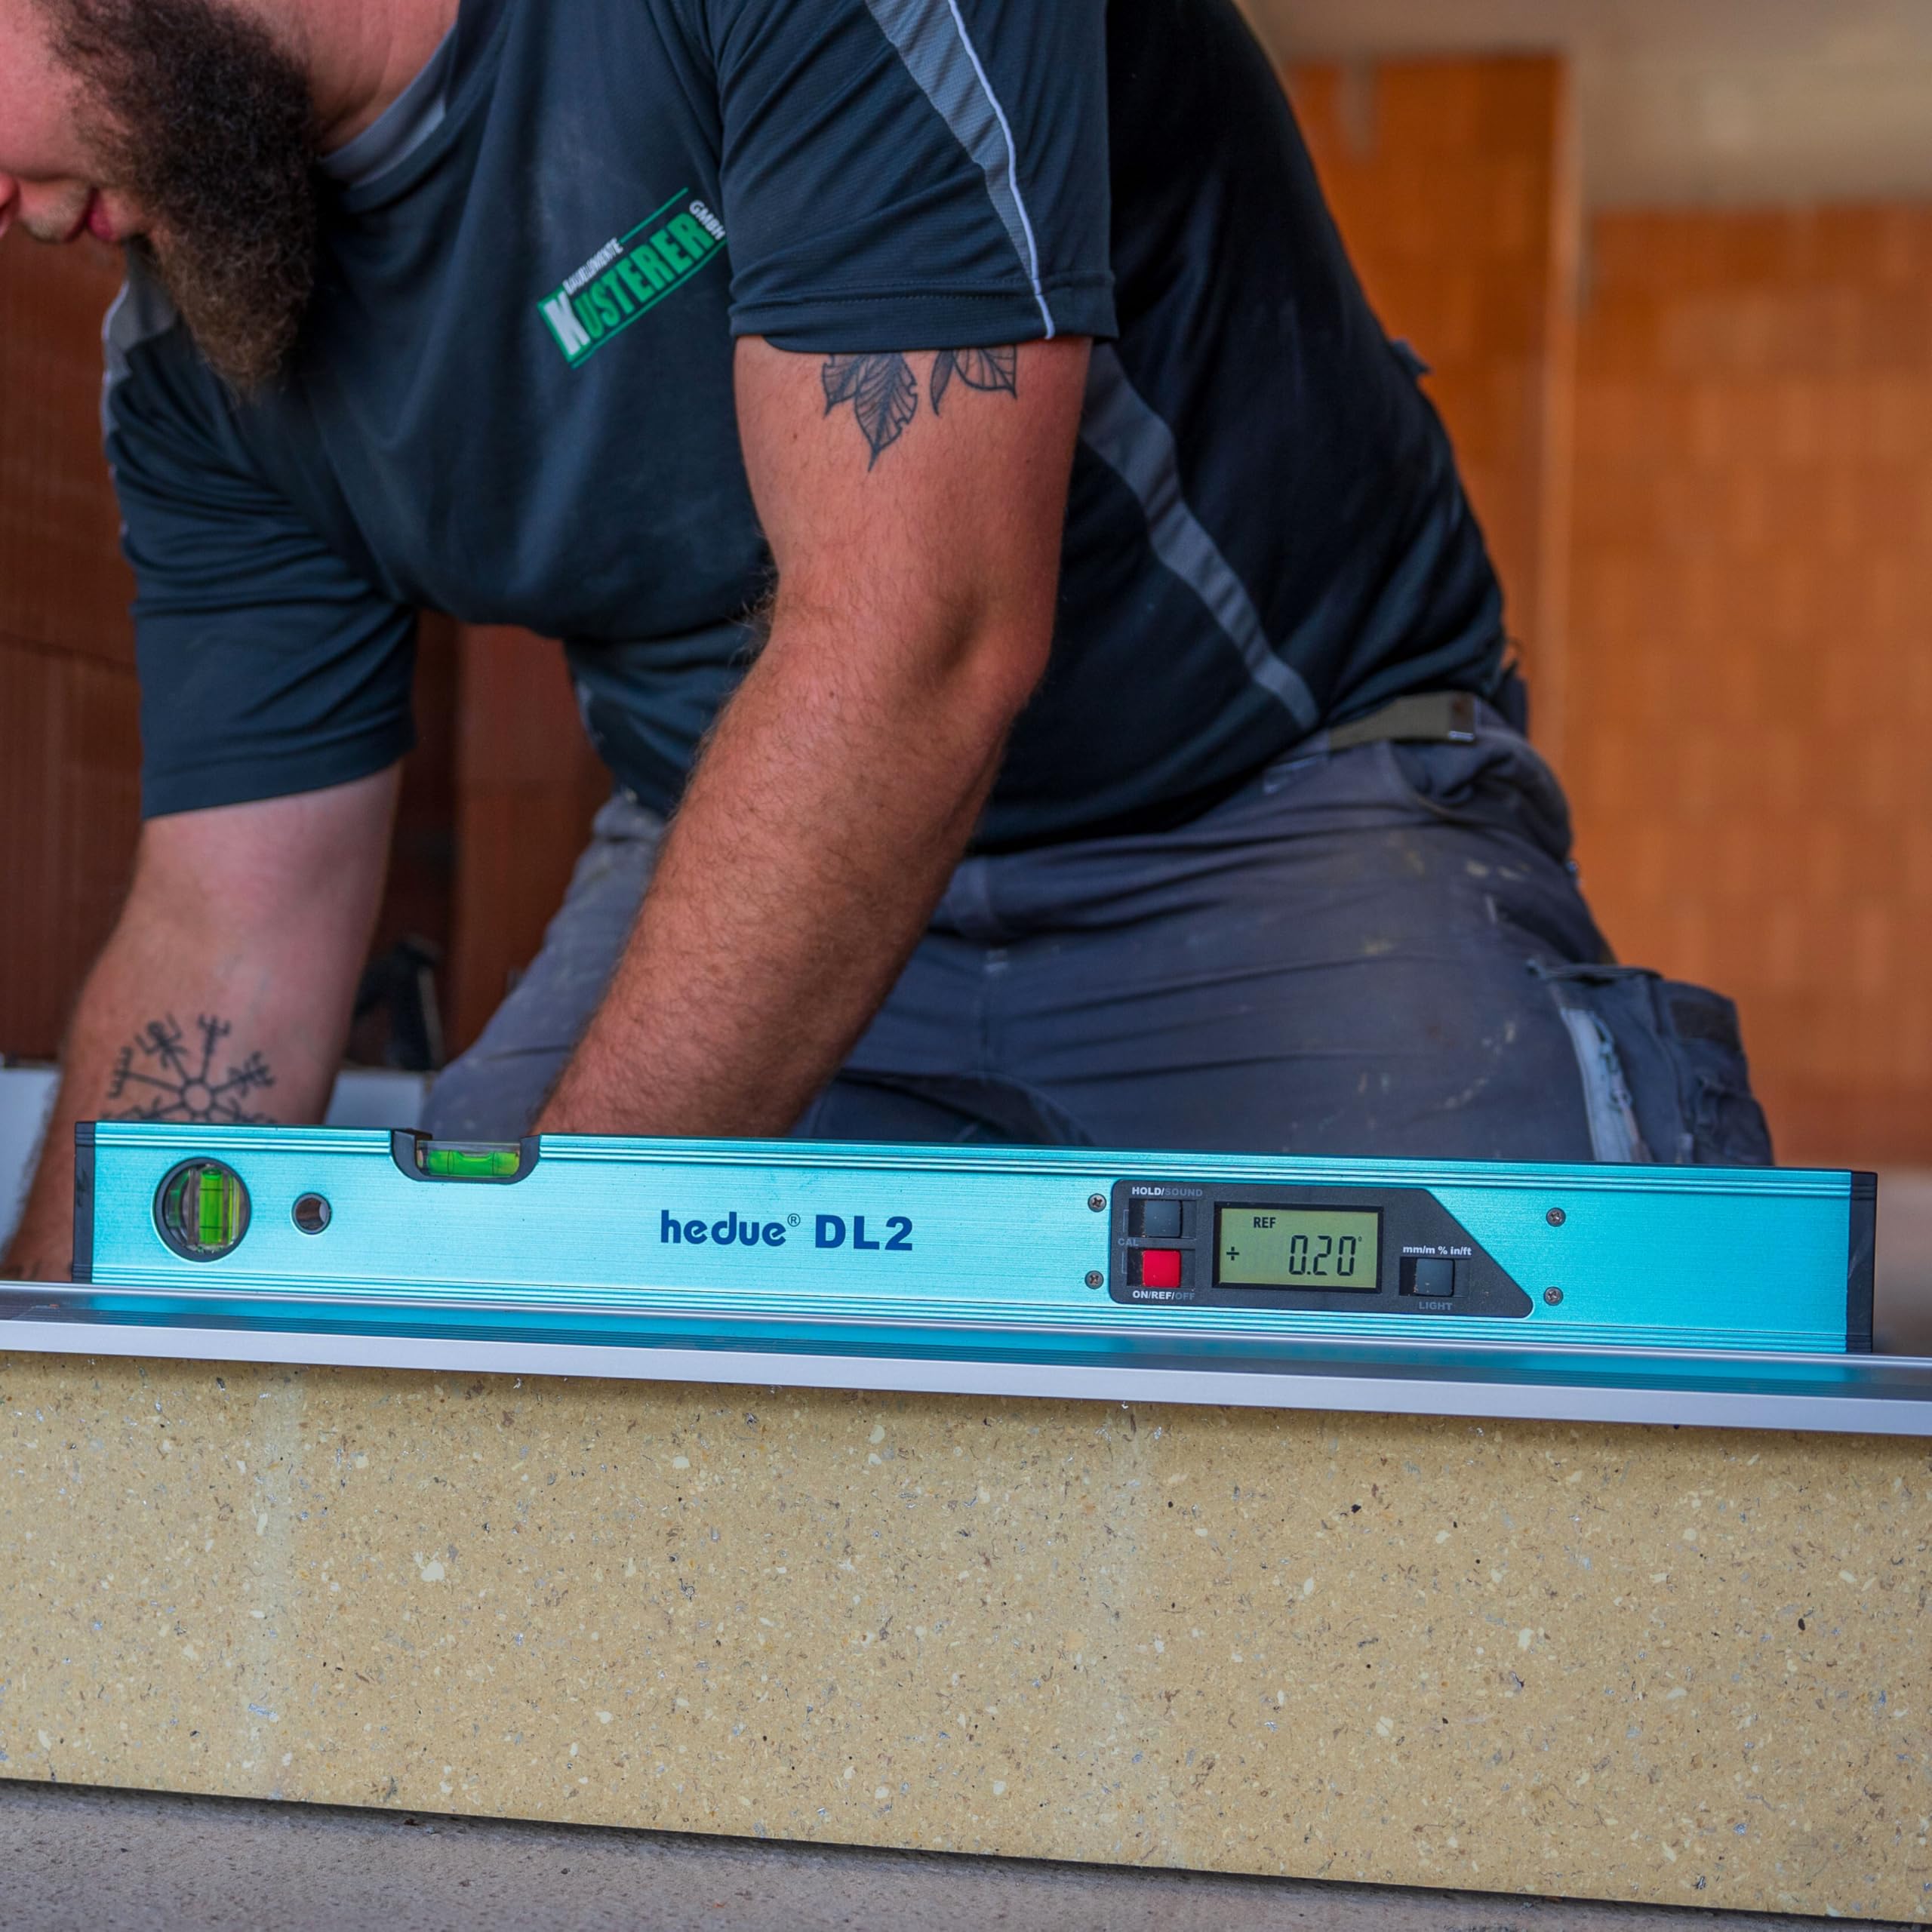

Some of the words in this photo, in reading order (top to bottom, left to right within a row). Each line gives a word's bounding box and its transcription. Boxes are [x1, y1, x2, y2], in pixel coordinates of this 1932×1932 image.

[689, 200, 725, 240] GMBH
[543, 211, 715, 356] KUSTERER
[1131, 1186, 1203, 1197] HOLD/SOUND
[1254, 1217, 1276, 1229] REF
[815, 1214, 913, 1251] DL2
[1117, 1238, 1140, 1247] CAL
[1402, 1245, 1435, 1254] mm/m
[1437, 1245, 1448, 1255] %
[1450, 1246, 1472, 1256] in/ft
[1132, 1290, 1195, 1300] ON/REF/OFF
[1418, 1301, 1453, 1311] LIGHT
